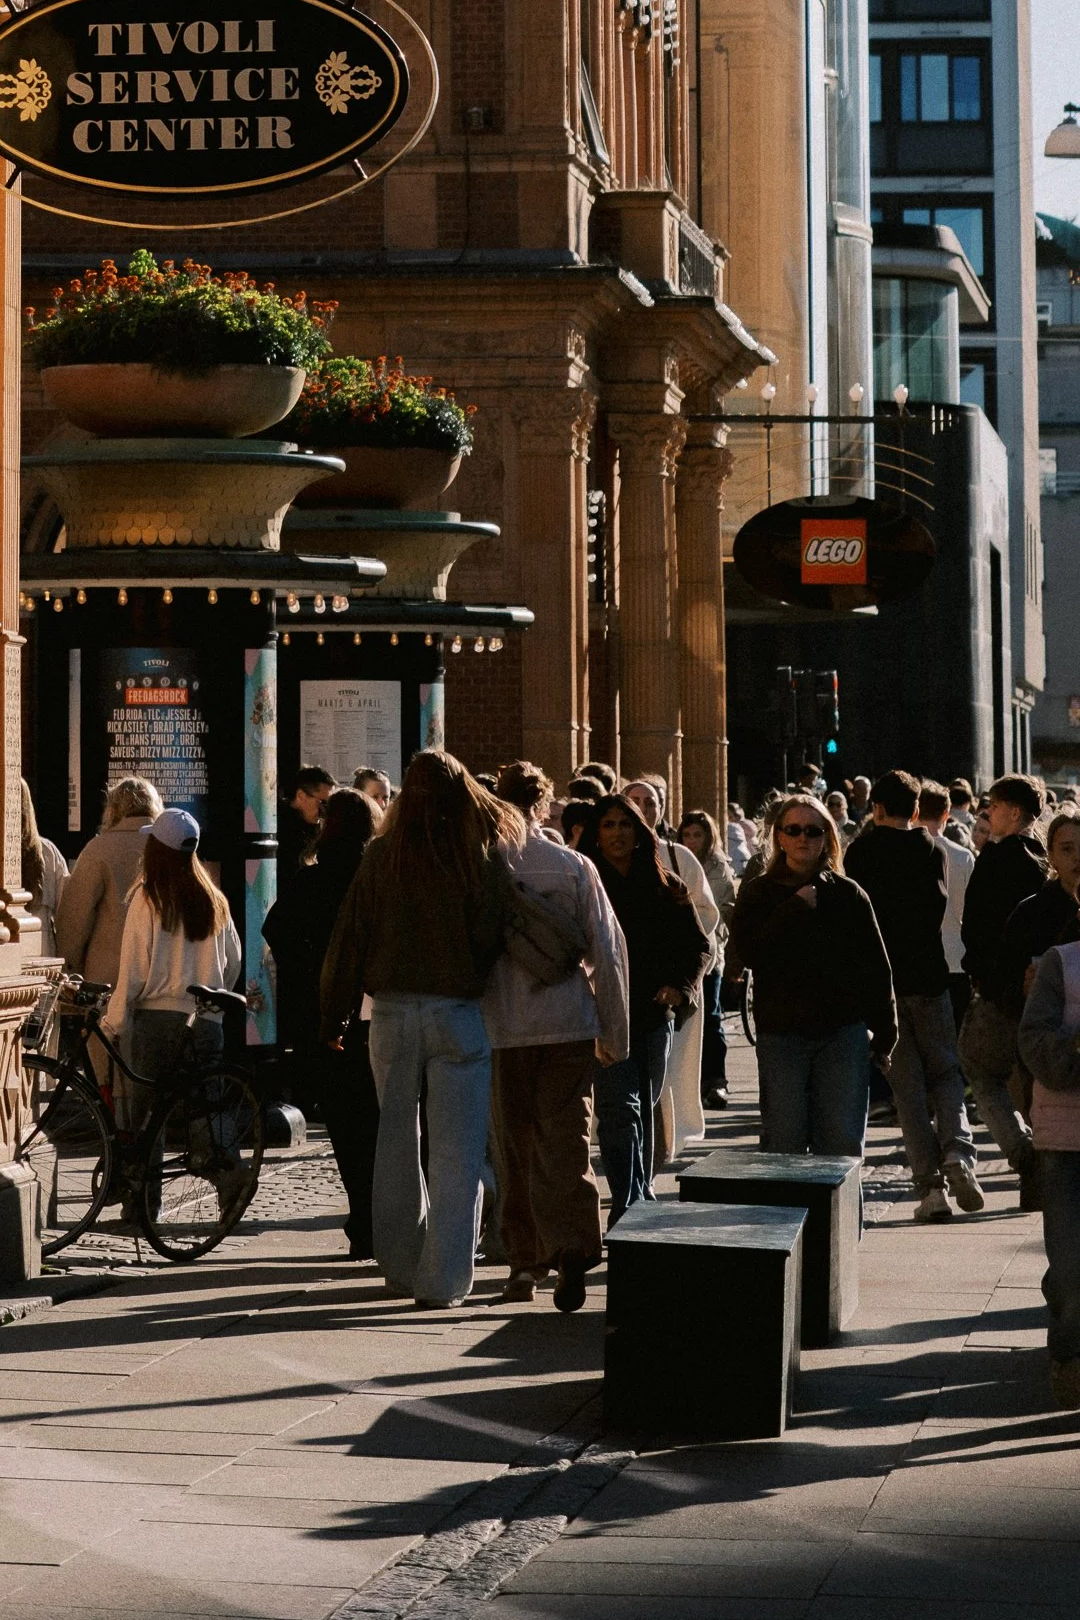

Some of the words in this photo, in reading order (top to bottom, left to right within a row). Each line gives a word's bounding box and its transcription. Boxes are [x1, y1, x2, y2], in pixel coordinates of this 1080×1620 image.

[88, 19, 277, 56] TIVOLI
[65, 67, 300, 105] SERVICE
[71, 115, 295, 153] CENTER
[805, 537, 864, 564] LEGO
[143, 659, 170, 668] TIVOLI
[128, 690, 186, 703] FREDAGSROCK
[357, 699, 381, 707] APRIL
[113, 709, 125, 721] FLO
[126, 709, 143, 721] RIDA
[147, 709, 161, 721] TLC
[166, 709, 191, 721] JESSIE
[107, 721, 122, 733] RICK
[123, 721, 149, 733] ASTLEY
[153, 721, 174, 733] BRAD
[175, 721, 206, 733] PAISLEY
[129, 734, 150, 745] HANS
[150, 734, 175, 745] PHILIP
[140, 746, 161, 758] DIZZY
[162, 746, 181, 758] MIZZ
[182, 746, 202, 758] LIZZY
